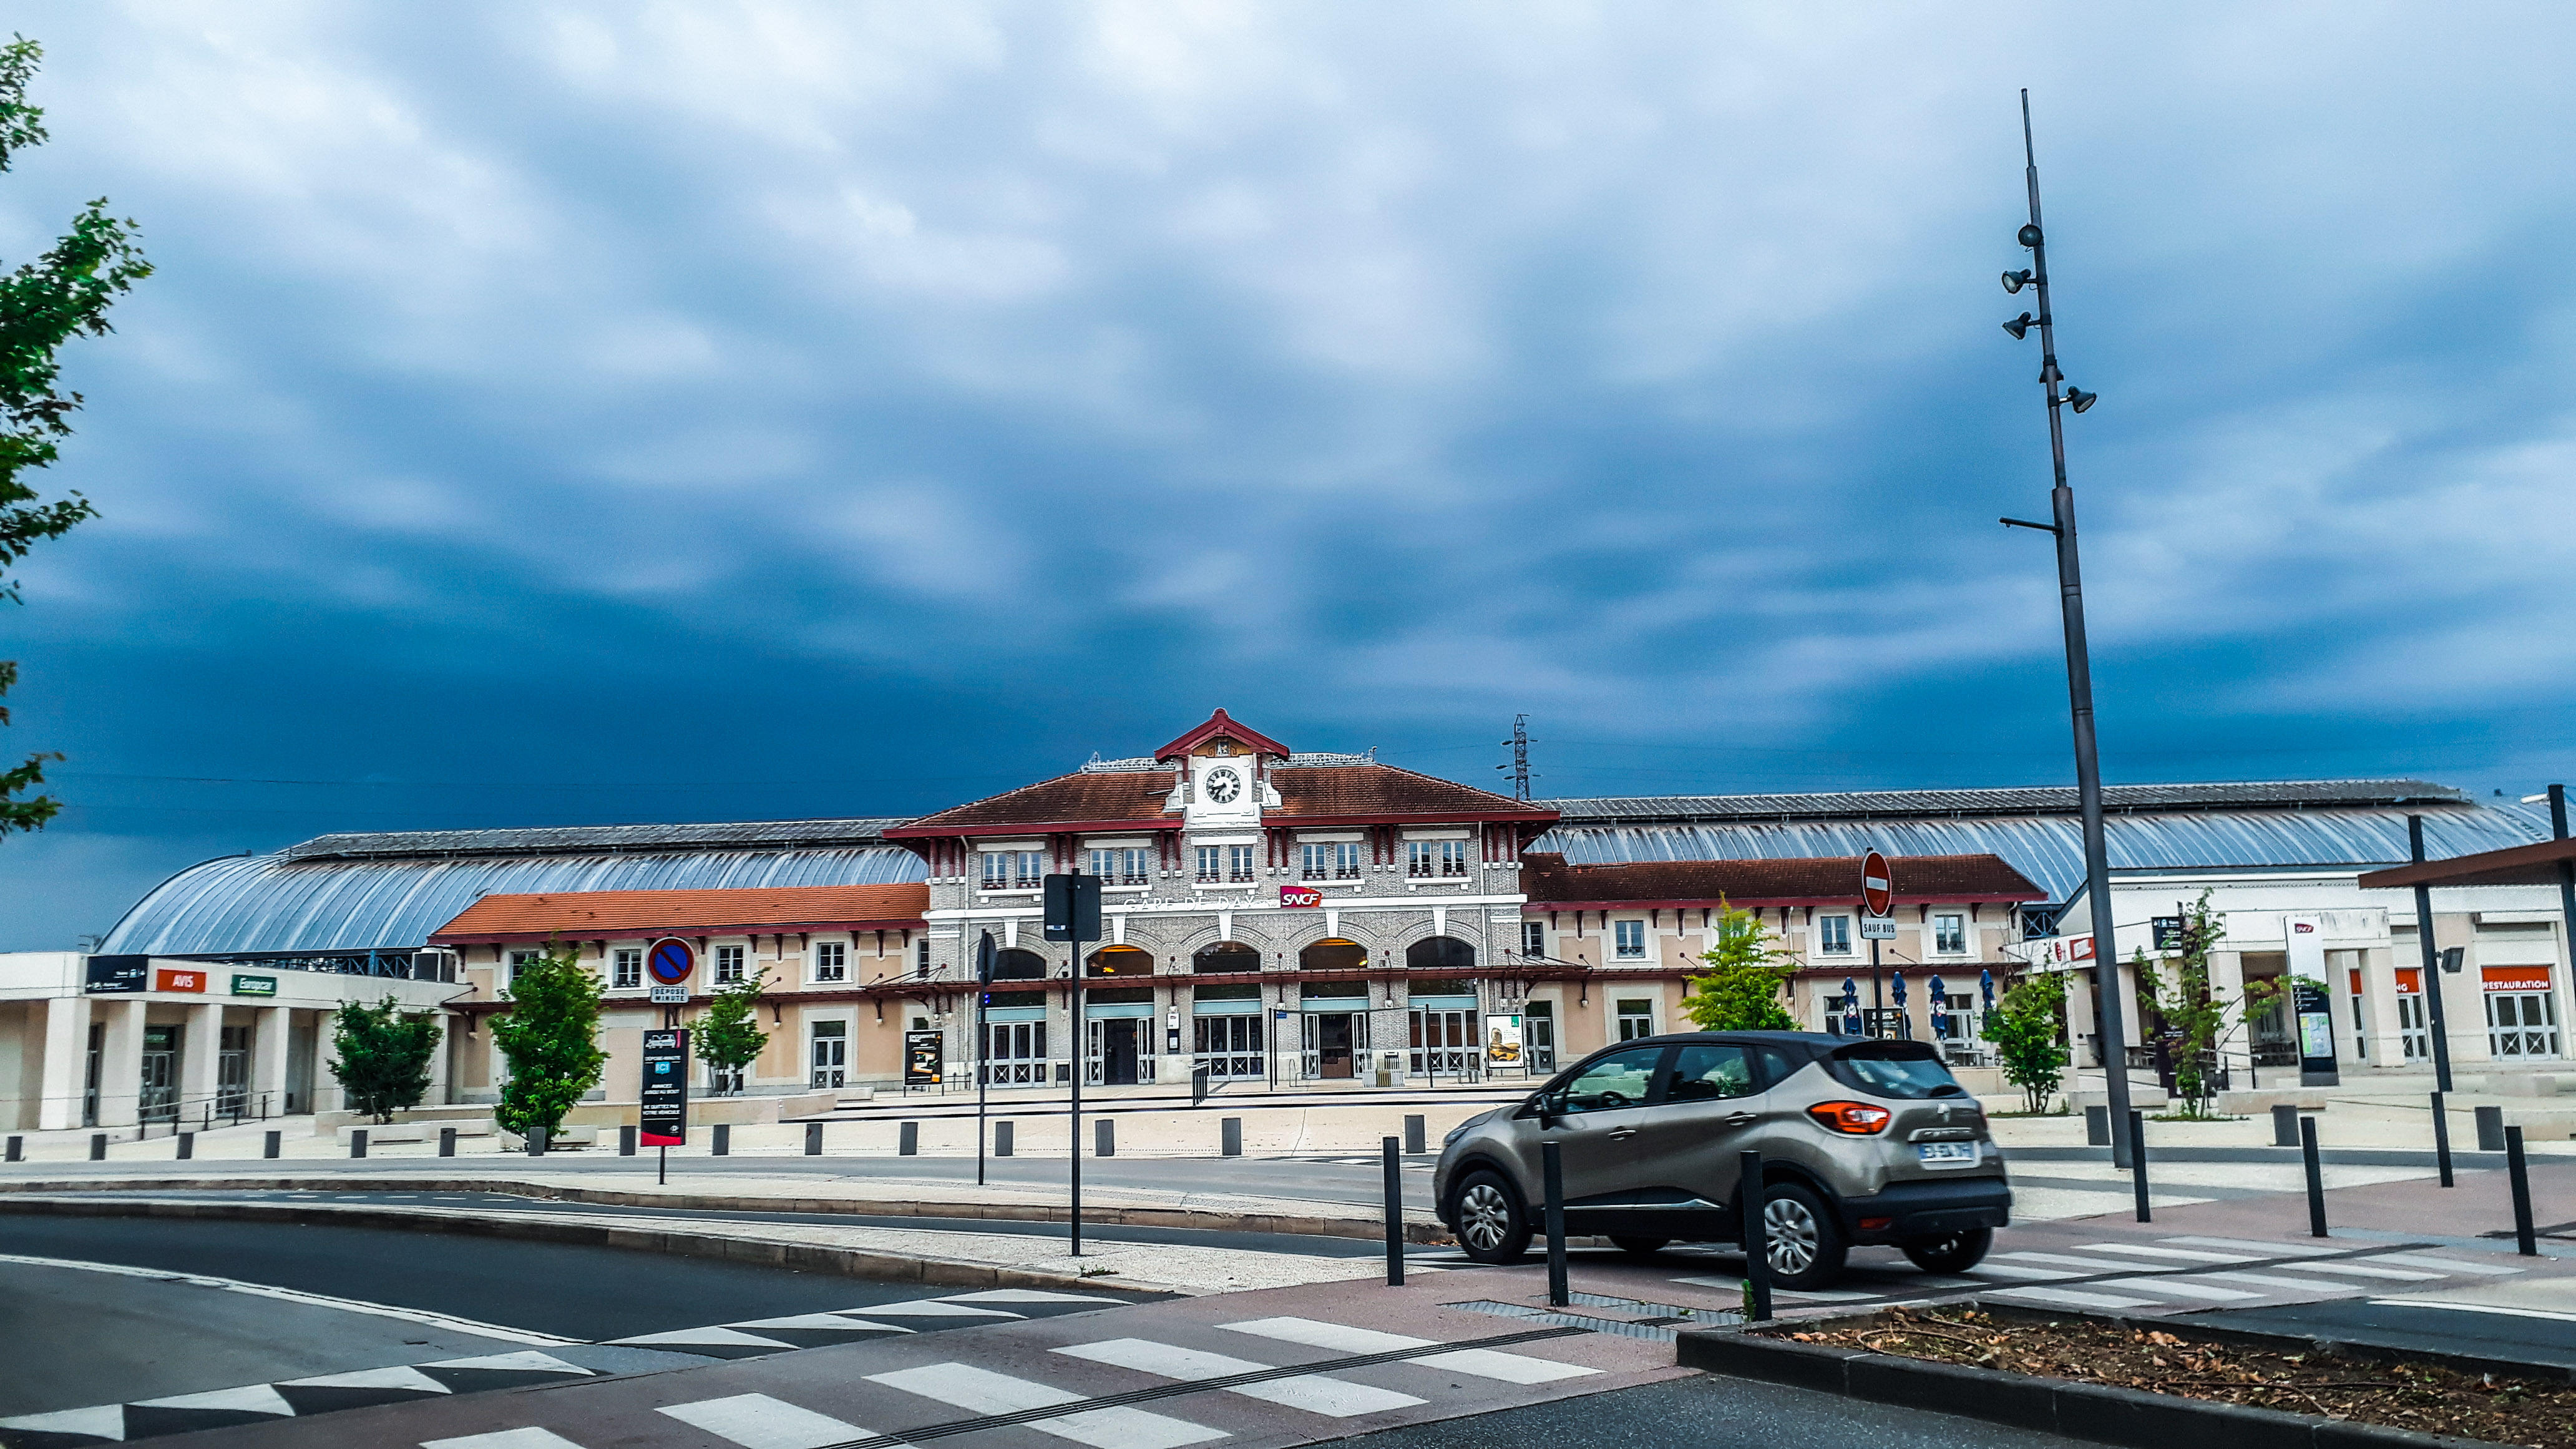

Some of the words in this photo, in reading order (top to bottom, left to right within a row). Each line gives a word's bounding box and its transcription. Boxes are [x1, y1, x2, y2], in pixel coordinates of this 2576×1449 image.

[1123, 897, 1173, 912] GARE
[1184, 896, 1206, 911] DE
[1218, 895, 1255, 910] DAX
[1282, 894, 1320, 905] SNCF
[1864, 924, 1880, 933] SAUF
[1883, 924, 1895, 933] BUS
[172, 975, 194, 988] AVIS
[2483, 980, 2549, 990] RESTAURATION
[655, 1063, 670, 1071] ICI
